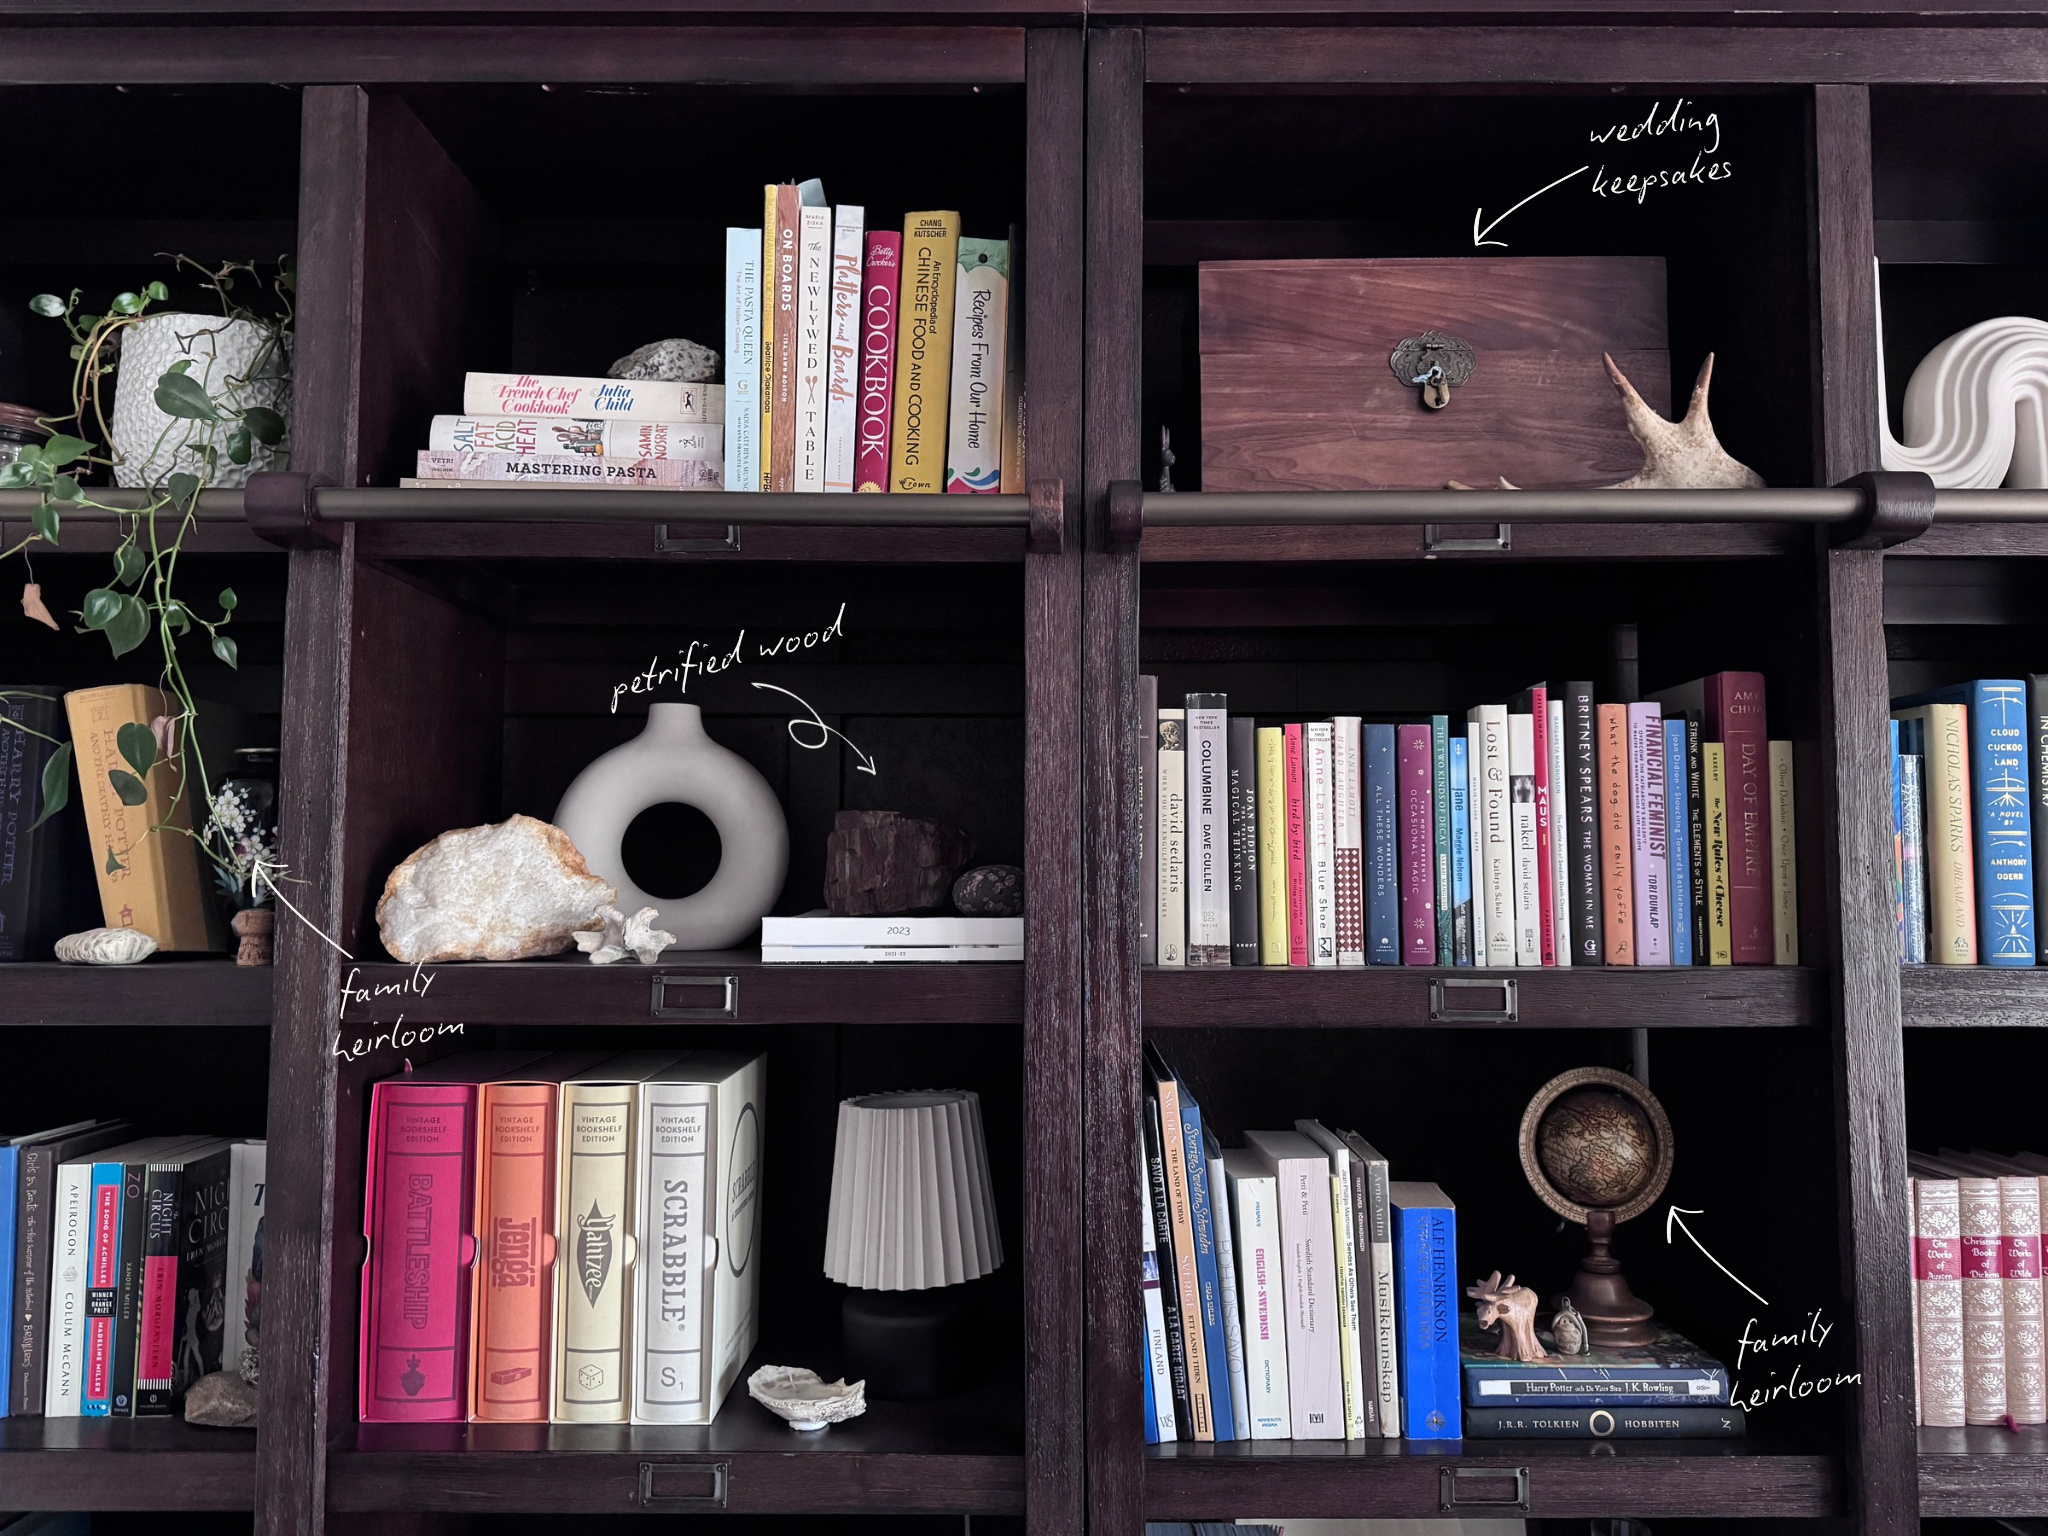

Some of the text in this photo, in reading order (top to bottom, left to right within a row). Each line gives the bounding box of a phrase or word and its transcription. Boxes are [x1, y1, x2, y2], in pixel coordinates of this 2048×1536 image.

[914, 230, 947, 238] KUTSCHER
[920, 219, 942, 227] CHANG
[808, 241, 822, 252] The
[866, 256, 896, 268] Crocker's
[870, 244, 894, 259] Betty
[781, 228, 793, 312] ON BOARDS
[833, 254, 861, 321] Platters
[929, 260, 942, 335] An Encyclopedia of
[742, 260, 754, 365] THE PASTA QUEEN
[806, 257, 821, 369] NEWLYWED
[835, 322, 849, 342] and
[829, 344, 854, 403] Boards
[861, 285, 891, 460] COOKBOOK
[905, 247, 932, 466] CHINESE FOOD AND COOKING
[965, 289, 992, 449] Recipes From Our Home
[492, 384, 582, 404] French Chef
[509, 375, 540, 388] The
[591, 384, 632, 398] Julia
[502, 398, 571, 415] Cookbook
[594, 397, 634, 411] Child
[453, 418, 475, 452] SALT
[474, 422, 495, 448] FAT
[495, 421, 516, 451] ACID
[516, 419, 537, 455] HEAT
[638, 425, 653, 460] SAMIN
[655, 423, 668, 460] NOSRAT
[805, 411, 817, 481] TABLE
[505, 462, 657, 479] MASTERING PASTA
[1689, 721, 1698, 754] STRUNK
[1987, 743, 2023, 752] CUCKOO
[1990, 728, 2020, 737] CLOUD
[1611, 755, 1620, 775] the
[1994, 758, 2019, 766] LAND
[1315, 747, 1327, 847] Anne Lamott
[1486, 721, 1505, 843] Lost & Found
[1609, 782, 1621, 805] dog
[1645, 715, 1666, 860] FINANCIAL FEMINIST
[1690, 771, 1700, 799] WHITE
[1201, 740, 1212, 892] COLUMBINE DAVE CULLEN
[1537, 786, 1547, 827] MAUS
[1578, 695, 1594, 930] BRITNEY SPEARS THE WOMAN IN ME
[1613, 812, 1623, 830] did
[1945, 717, 1965, 928] NICHOLAS SPARKS DREAMLAND
[1170, 793, 1183, 893] david sedaris
[1246, 788, 1256, 871] JOAN DIDION
[1290, 798, 1301, 861] bird by bird
[1520, 815, 1534, 850] naked
[1692, 823, 1702, 867] ELEMENTS
[1613, 844, 1625, 878] emily
[1694, 868, 1700, 876] OF
[1712, 811, 1725, 928] New Rules of Cheese
[1990, 858, 2027, 866] ANTHONY
[1996, 873, 2024, 881] DOERR
[1317, 861, 1328, 929] Blue Shoe
[1613, 885, 1627, 924] yoffe
[1648, 874, 1659, 929] TORI DUNLAP
[1695, 878, 1704, 907] STYLE
[886, 926, 911, 936] 2023
[576, 1125, 622, 1134] BOOKSHELF
[580, 1116, 617, 1124] VINTAGE
[655, 1125, 702, 1134] BOOKSHELF
[660, 1116, 696, 1124] VINTAGE
[1164, 1091, 1178, 1144] SWEDEN
[581, 1135, 615, 1143] EDITION
[661, 1135, 694, 1143] EDITION
[67, 1184, 79, 1256] APEIROGON
[149, 1189, 162, 1239] CIRCUS
[160, 1192, 174, 1236] NIGHT
[102, 1233, 109, 1244] OF
[404, 1173, 433, 1330] BATTLESHIP
[491, 1217, 536, 1288] Jenga
[577, 1214, 617, 1288] Yahtzee
[1305, 1238, 1313, 1265] Swedish
[1963, 1236, 2001, 1245] Christmas
[1971, 1248, 1997, 1257] Books
[100, 1246, 108, 1284] ACHILLES
[1432, 1217, 1448, 1343] ALF HENRIKSON
[1969, 1270, 2000, 1279] Dickens
[1981, 1259, 1990, 1268] of
[1255, 1248, 1270, 1340] ENGLISH-SWEDISH
[1306, 1266, 1315, 1296] Standard
[61, 1292, 74, 1396] COLUM McCANN
[96, 1321, 104, 1361] MADELINE
[1153, 1329, 1165, 1375] FINLAND
[1378, 1270, 1393, 1403] Musikkunskap
[1526, 1383, 1674, 1394] Harry Potter Rowling
[1498, 1420, 1580, 1429] J.R.R. TOLKIEN
[1624, 1420, 1680, 1428] HOBBITEN
